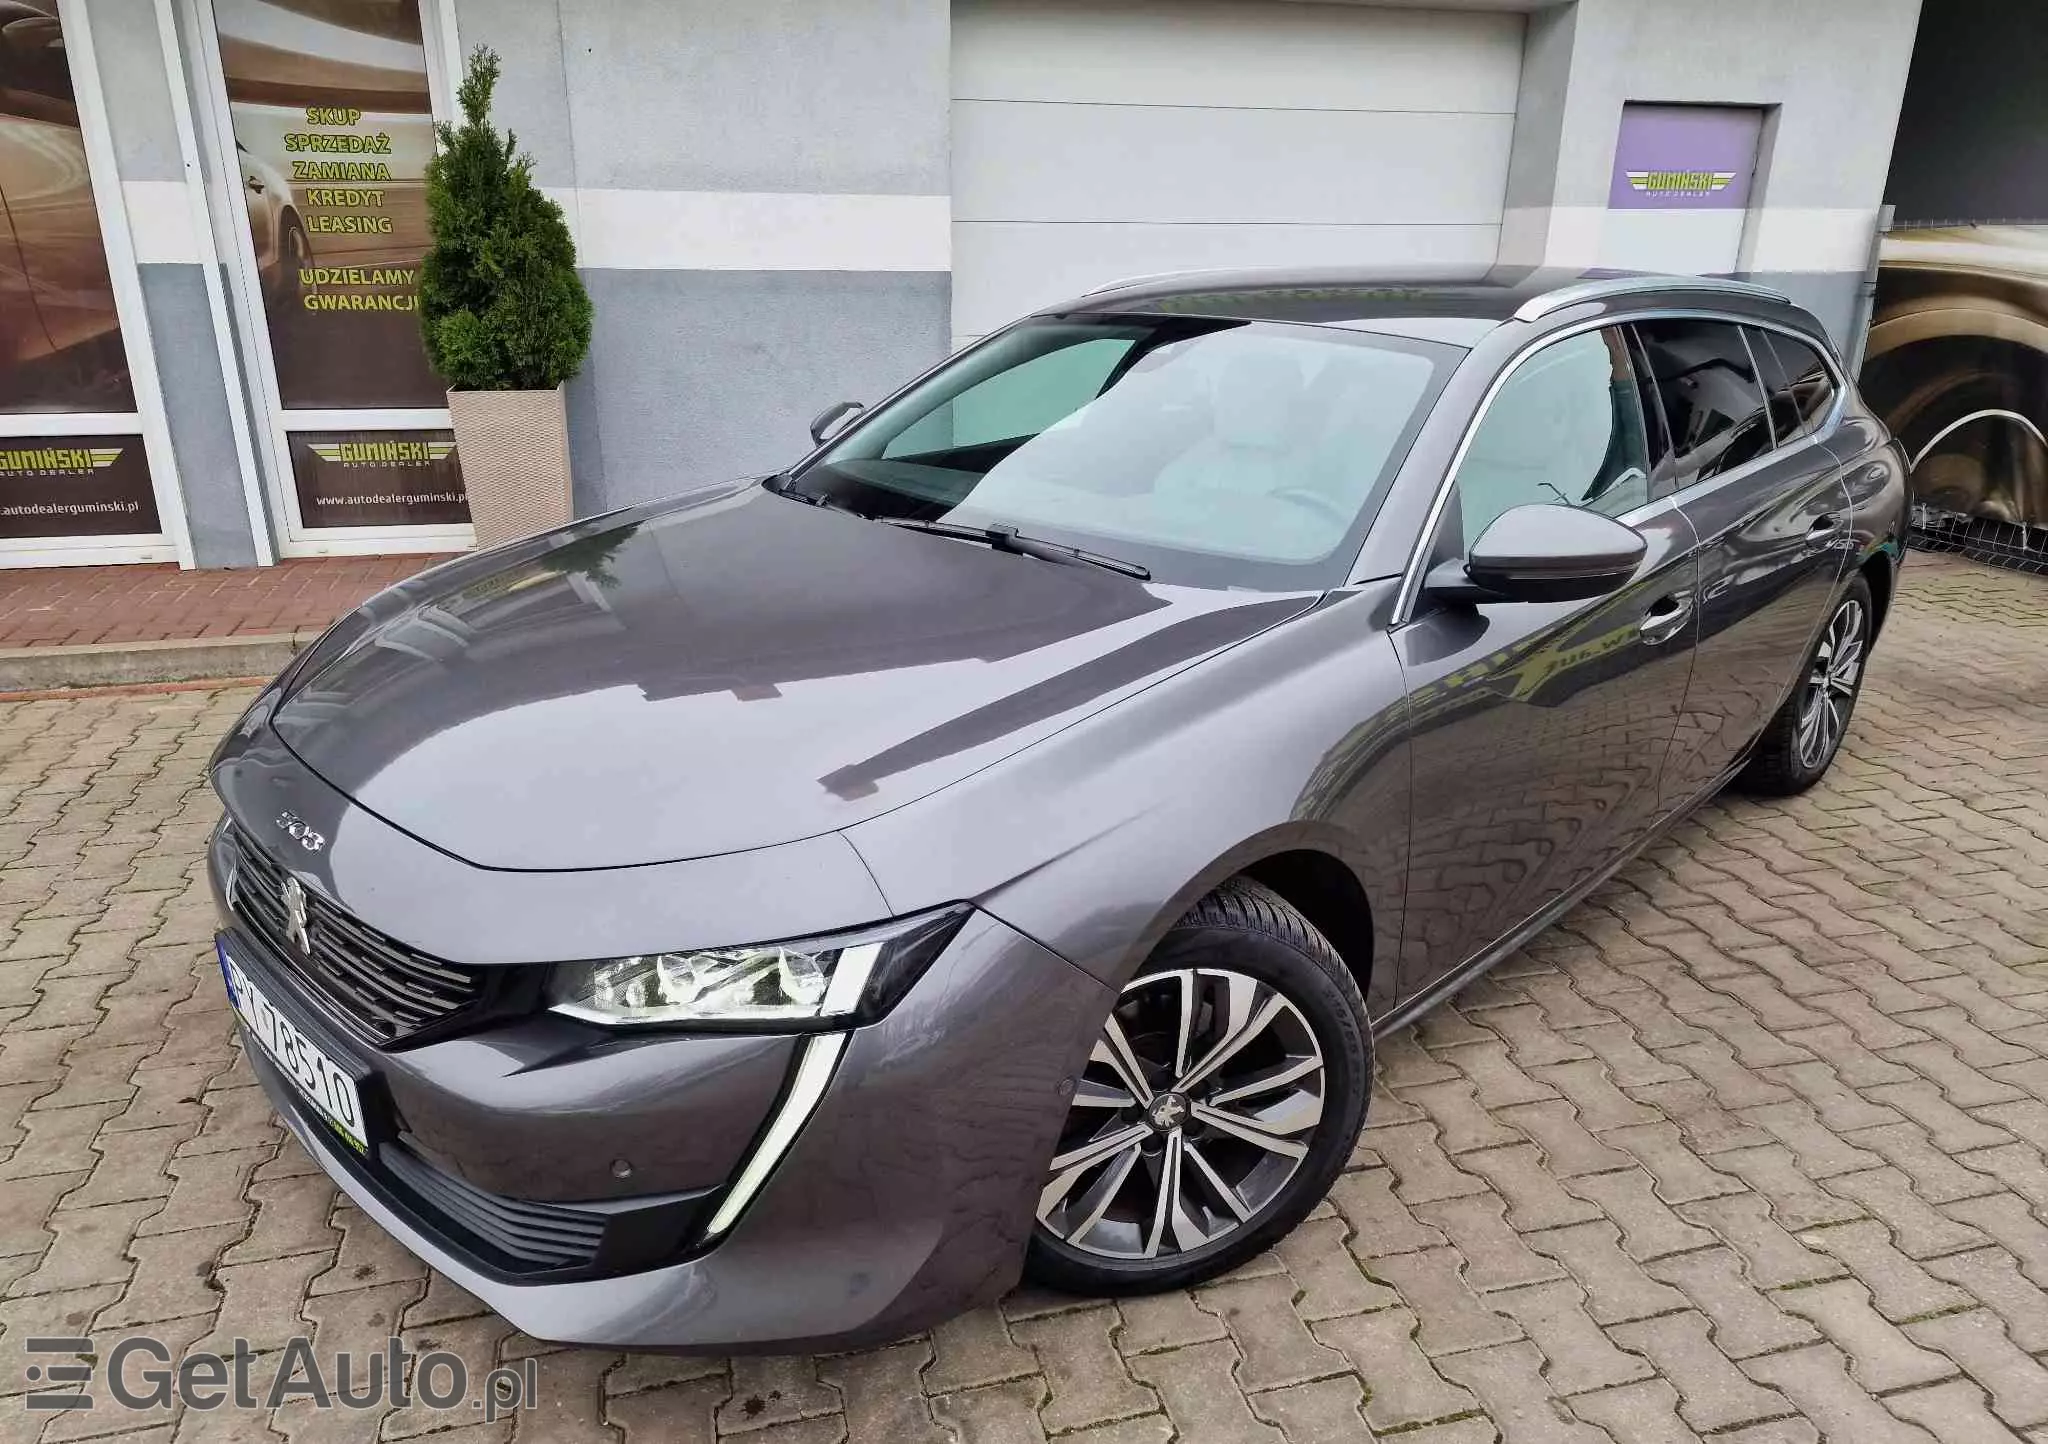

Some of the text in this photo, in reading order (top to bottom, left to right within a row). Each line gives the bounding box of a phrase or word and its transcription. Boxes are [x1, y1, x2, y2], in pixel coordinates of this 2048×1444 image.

[306, 107, 361, 125] SKUP
[284, 132, 392, 154] SPRZEDAŻ
[292, 161, 392, 180] ZAMIANA
[306, 188, 384, 207] KREDYT
[306, 215, 393, 233] LEASING
[299, 268, 415, 285] UDZIELAMY
[339, 440, 429, 461] GUMIŃSKI
[275, 811, 325, 851] 508
[264, 1002, 355, 1127] 78510
